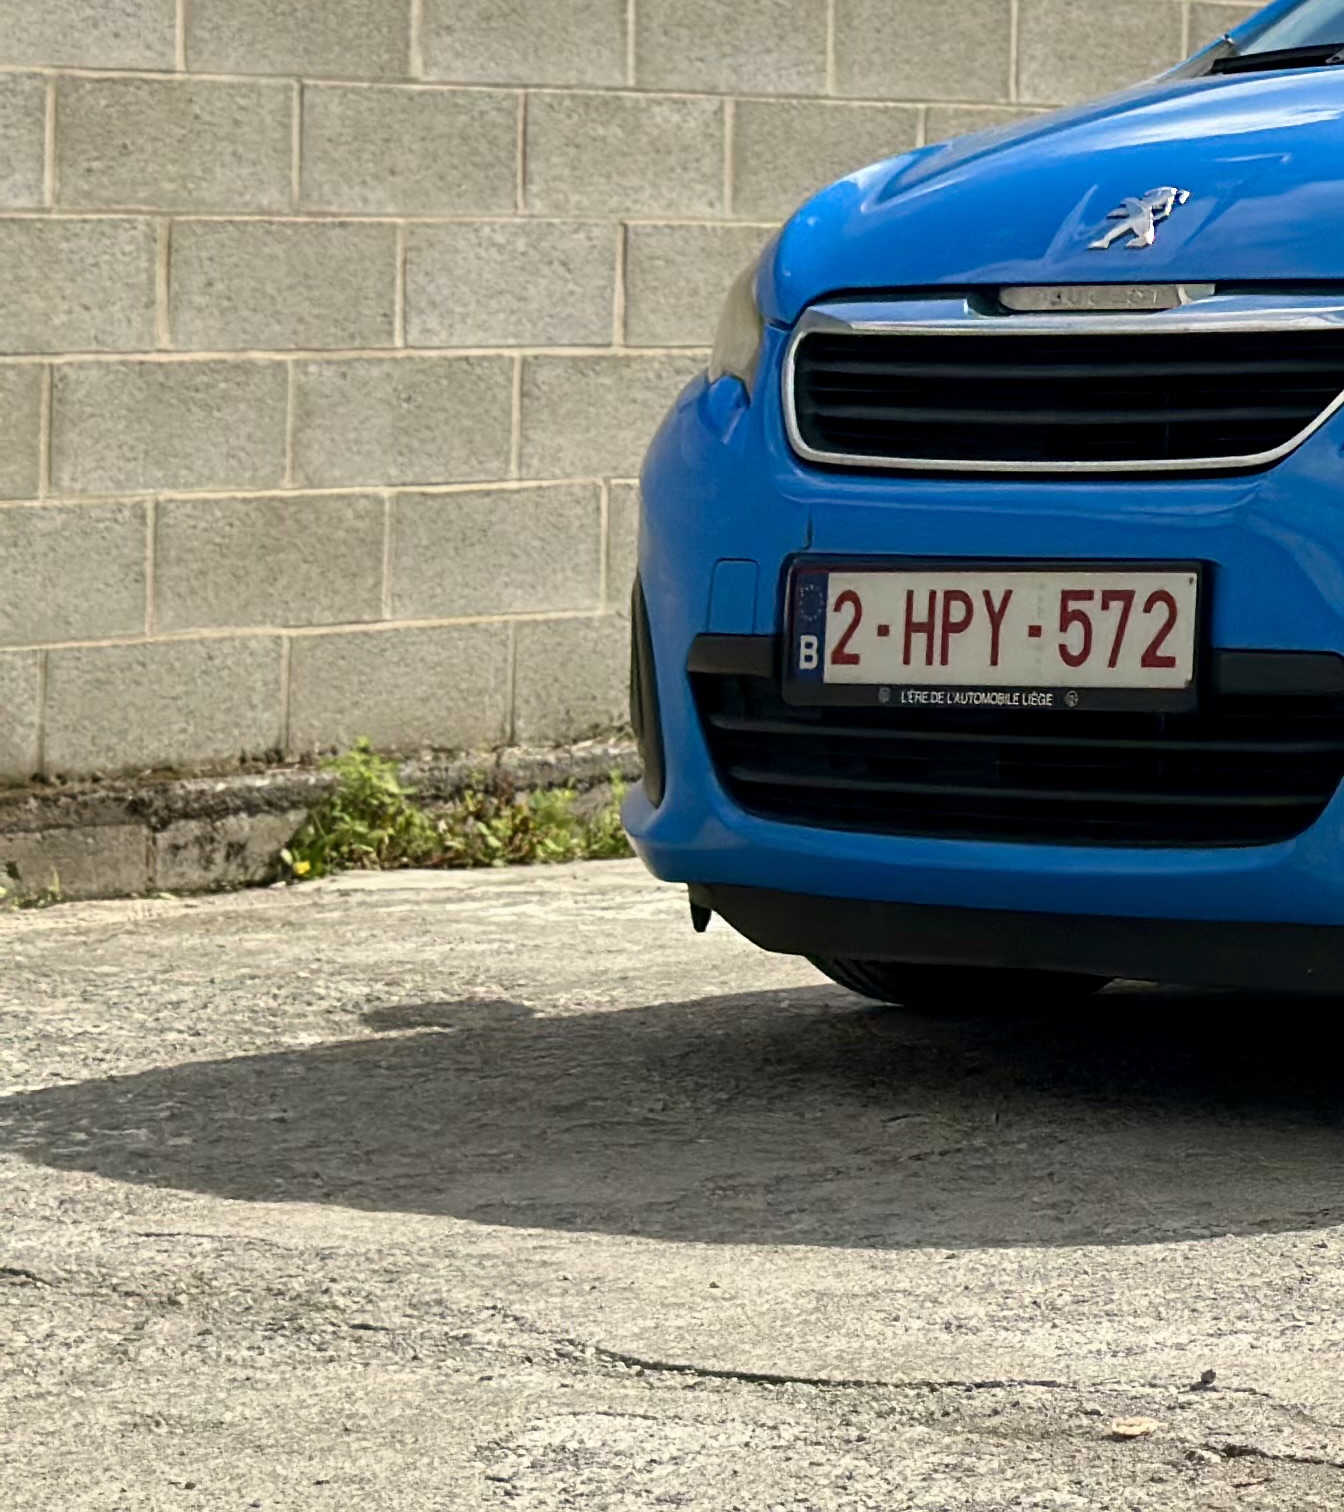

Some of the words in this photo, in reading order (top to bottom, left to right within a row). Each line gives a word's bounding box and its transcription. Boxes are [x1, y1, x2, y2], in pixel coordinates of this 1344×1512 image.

[830, 588, 1178, 669] 2-HPY-572
[799, 635, 819, 670] B
[930, 691, 945, 704] DE
[946, 691, 1020, 706] L'AUTOMOBILE
